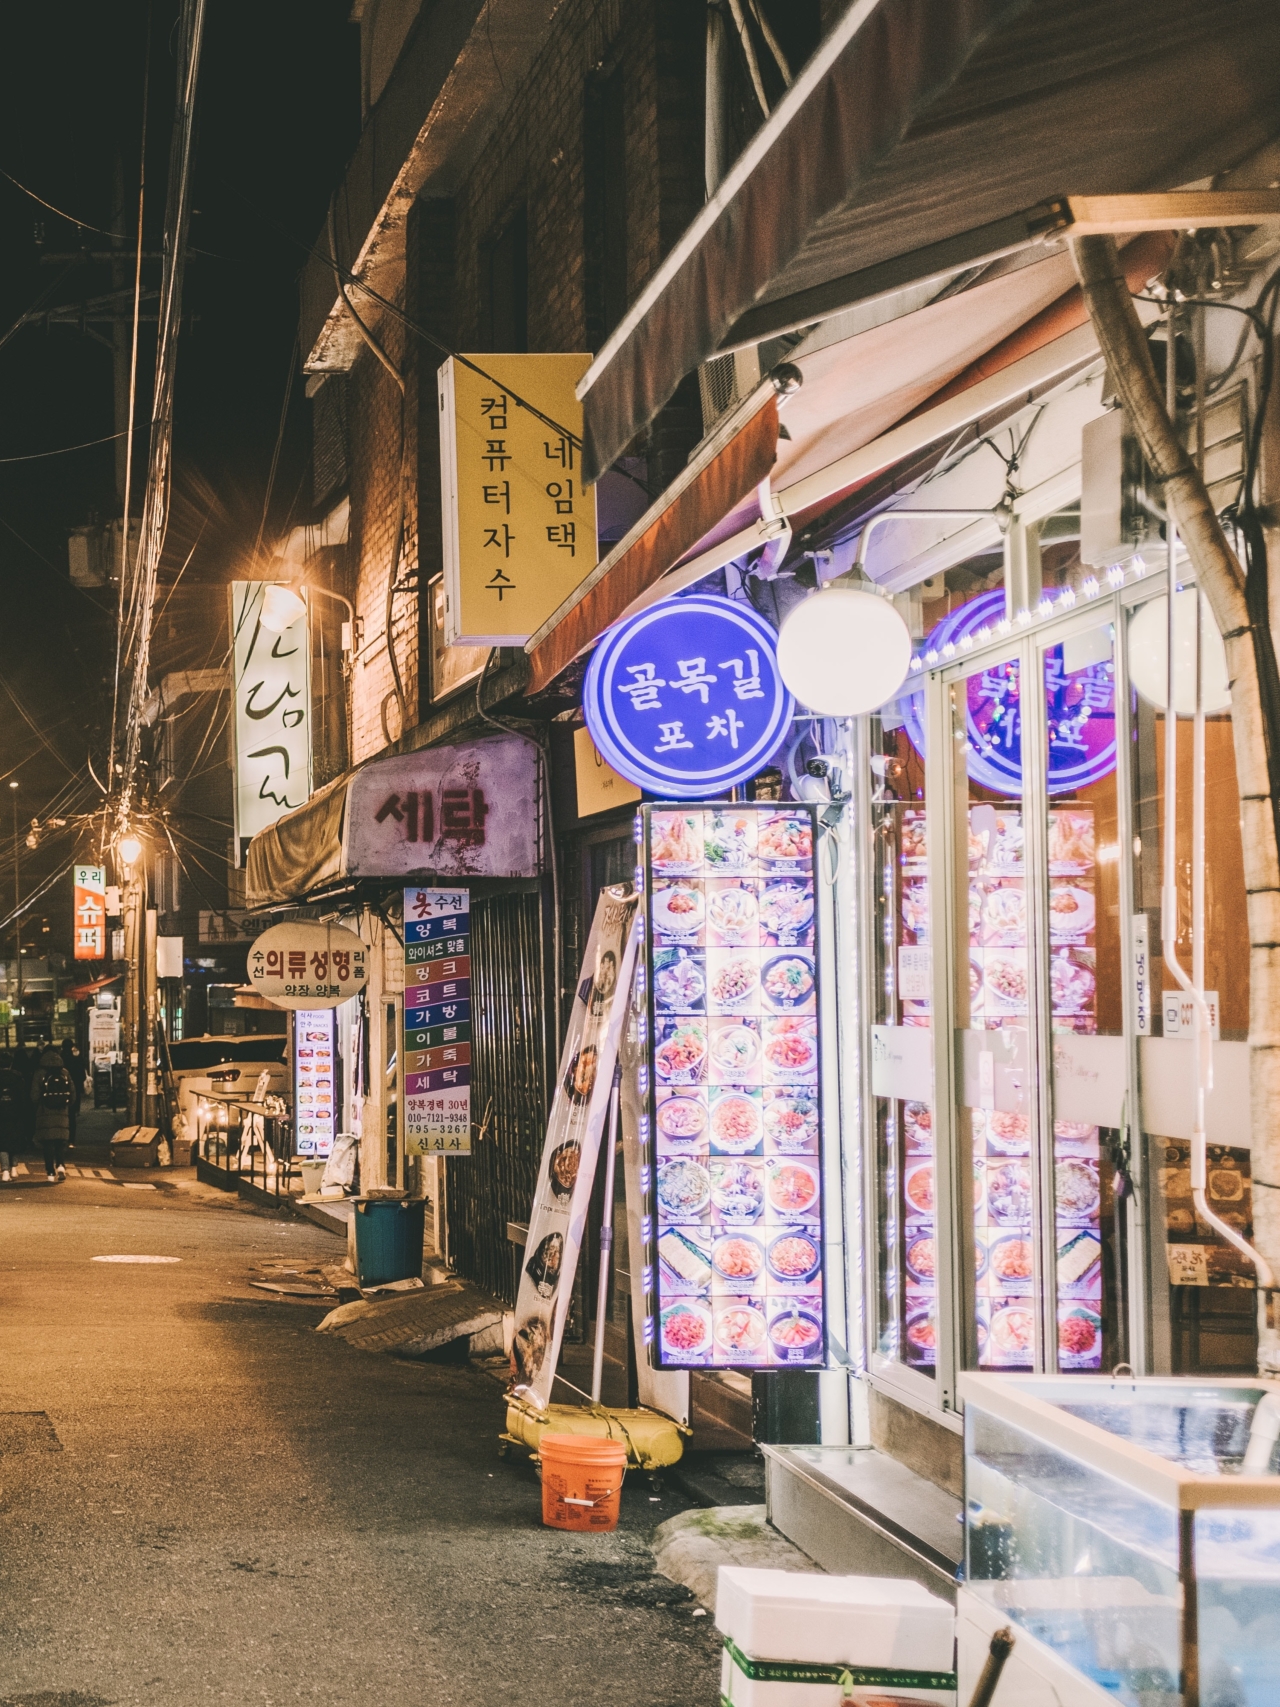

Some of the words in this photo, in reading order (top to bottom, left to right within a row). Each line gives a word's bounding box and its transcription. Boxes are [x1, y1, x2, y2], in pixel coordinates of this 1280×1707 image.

[481, 395, 516, 601] 컴퓨터자수
[544, 438, 576, 557] 네임택
[618, 649, 765, 711] 골목길
[654, 709, 744, 752] 포차
[375, 788, 489, 846] 세탁
[78, 871, 101, 885] 우리
[434, 895, 463, 911] 수선
[77, 896, 103, 955] 슈퍼
[415, 918, 457, 938] 양복
[408, 943, 443, 960] 와이셔츠
[447, 939, 464, 954] 맞춤
[252, 951, 265, 978] 수선
[266, 950, 350, 981] 의류성형
[353, 951, 365, 978] 리폼
[415, 961, 457, 980] 밍크
[285, 984, 310, 997] 양장
[315, 984, 341, 997] 양복
[416, 983, 457, 1003] 코트
[415, 1005, 457, 1023] 가방
[416, 1048, 457, 1067] 가죽
[415, 1070, 458, 1089] 세탁
[408, 1099, 444, 1111] 양복경력
[448, 1099, 468, 1111] 30년
[408, 1113, 467, 1123] 010-7121-9348
[417, 1137, 461, 1150] 신신사
